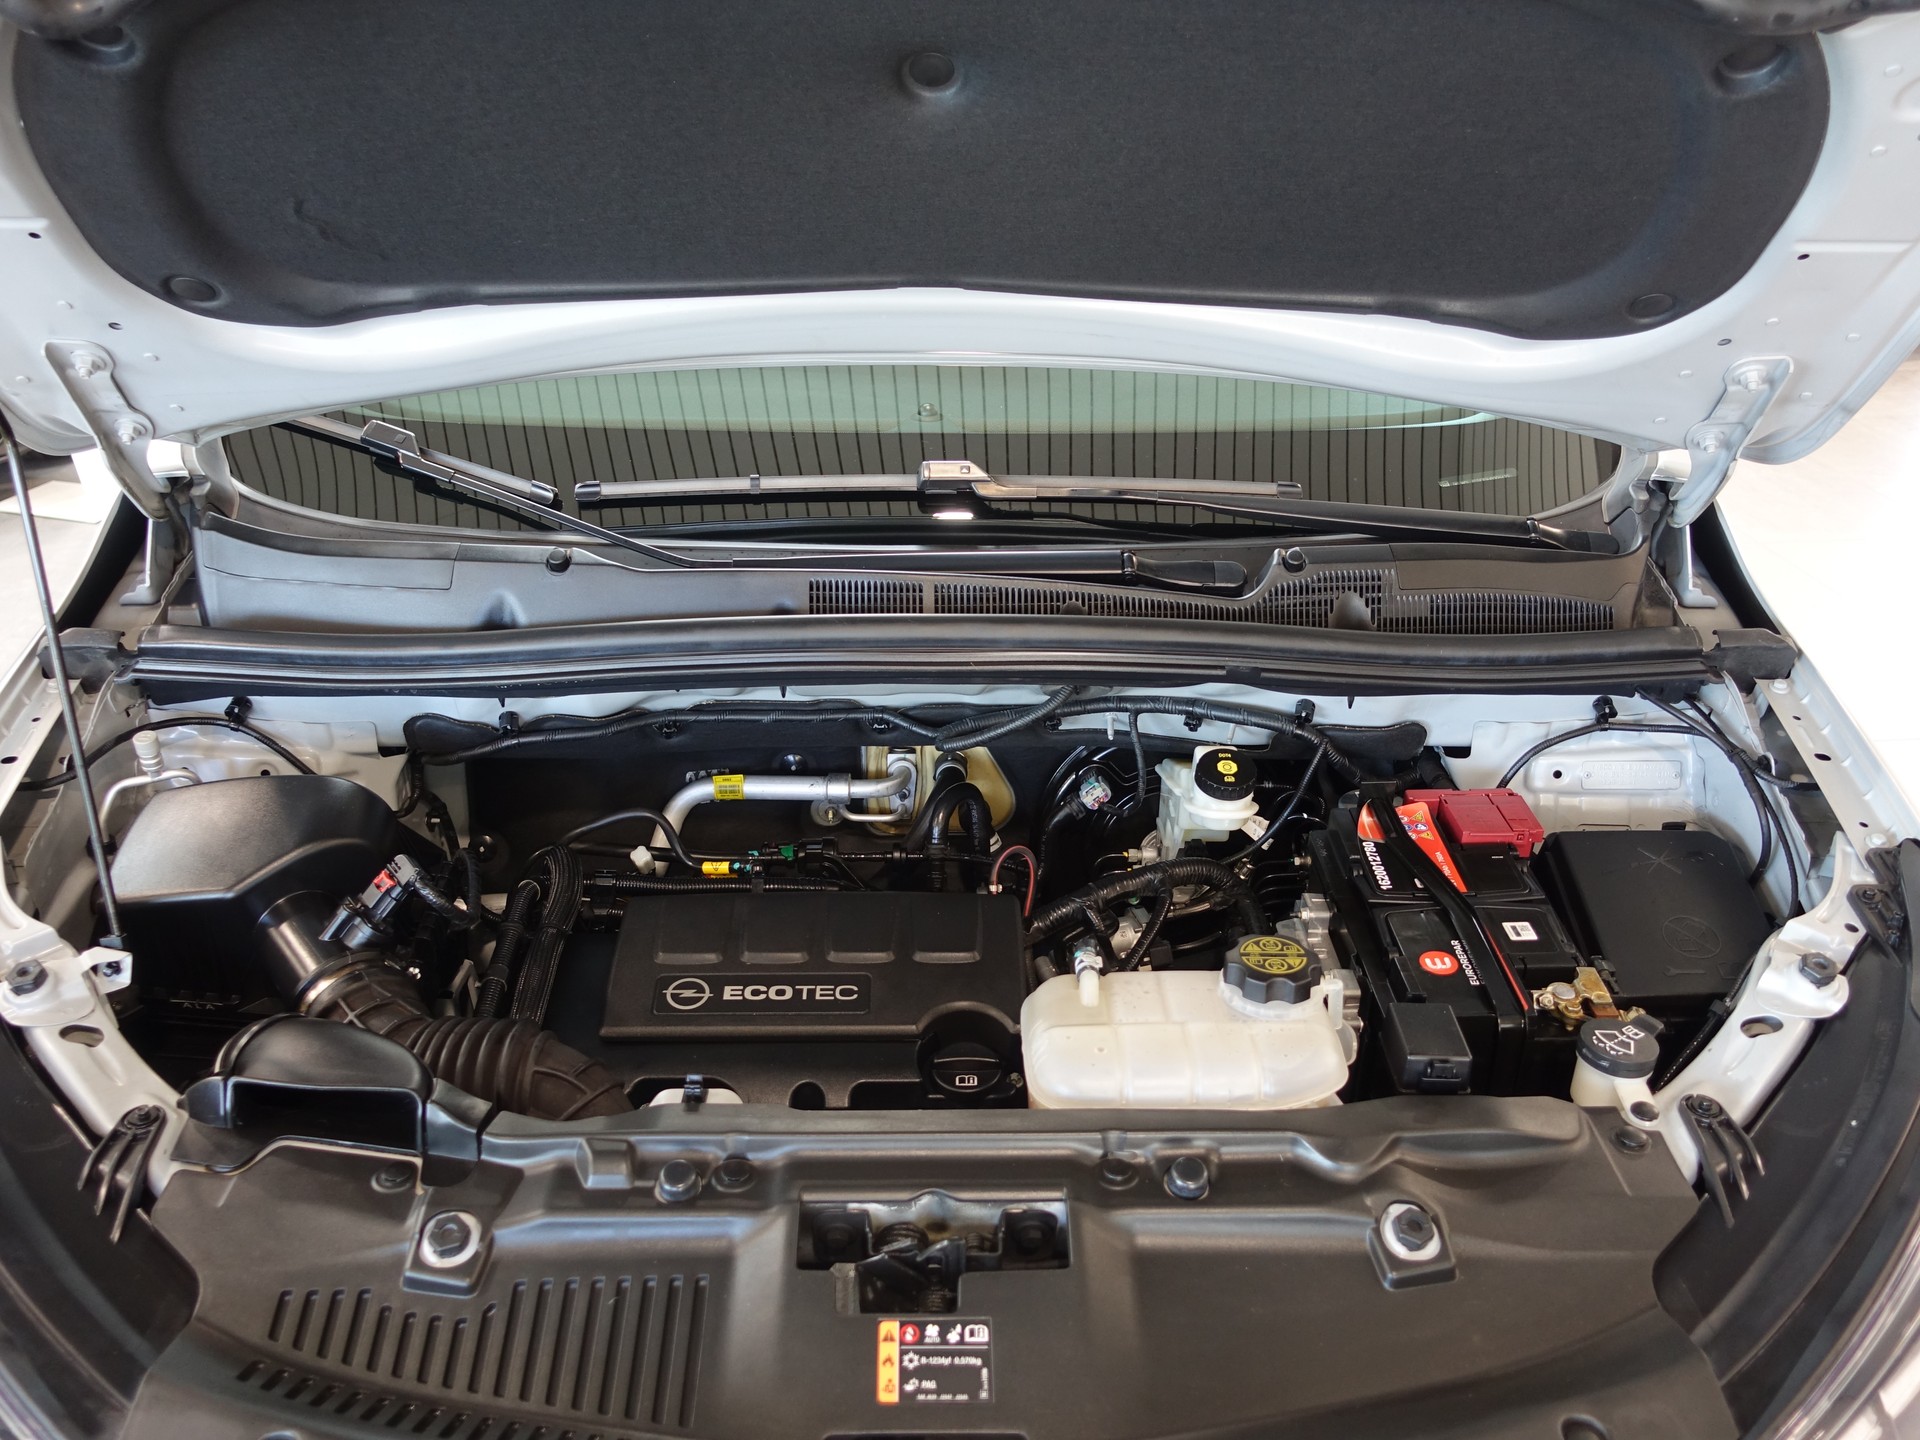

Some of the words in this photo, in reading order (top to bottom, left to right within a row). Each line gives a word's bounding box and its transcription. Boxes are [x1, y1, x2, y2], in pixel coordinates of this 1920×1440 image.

[1362, 842, 1392, 890] 1620012780
[1450, 940, 1480, 986] EUROREPAR
[723, 985, 858, 1000] ECOTEC
